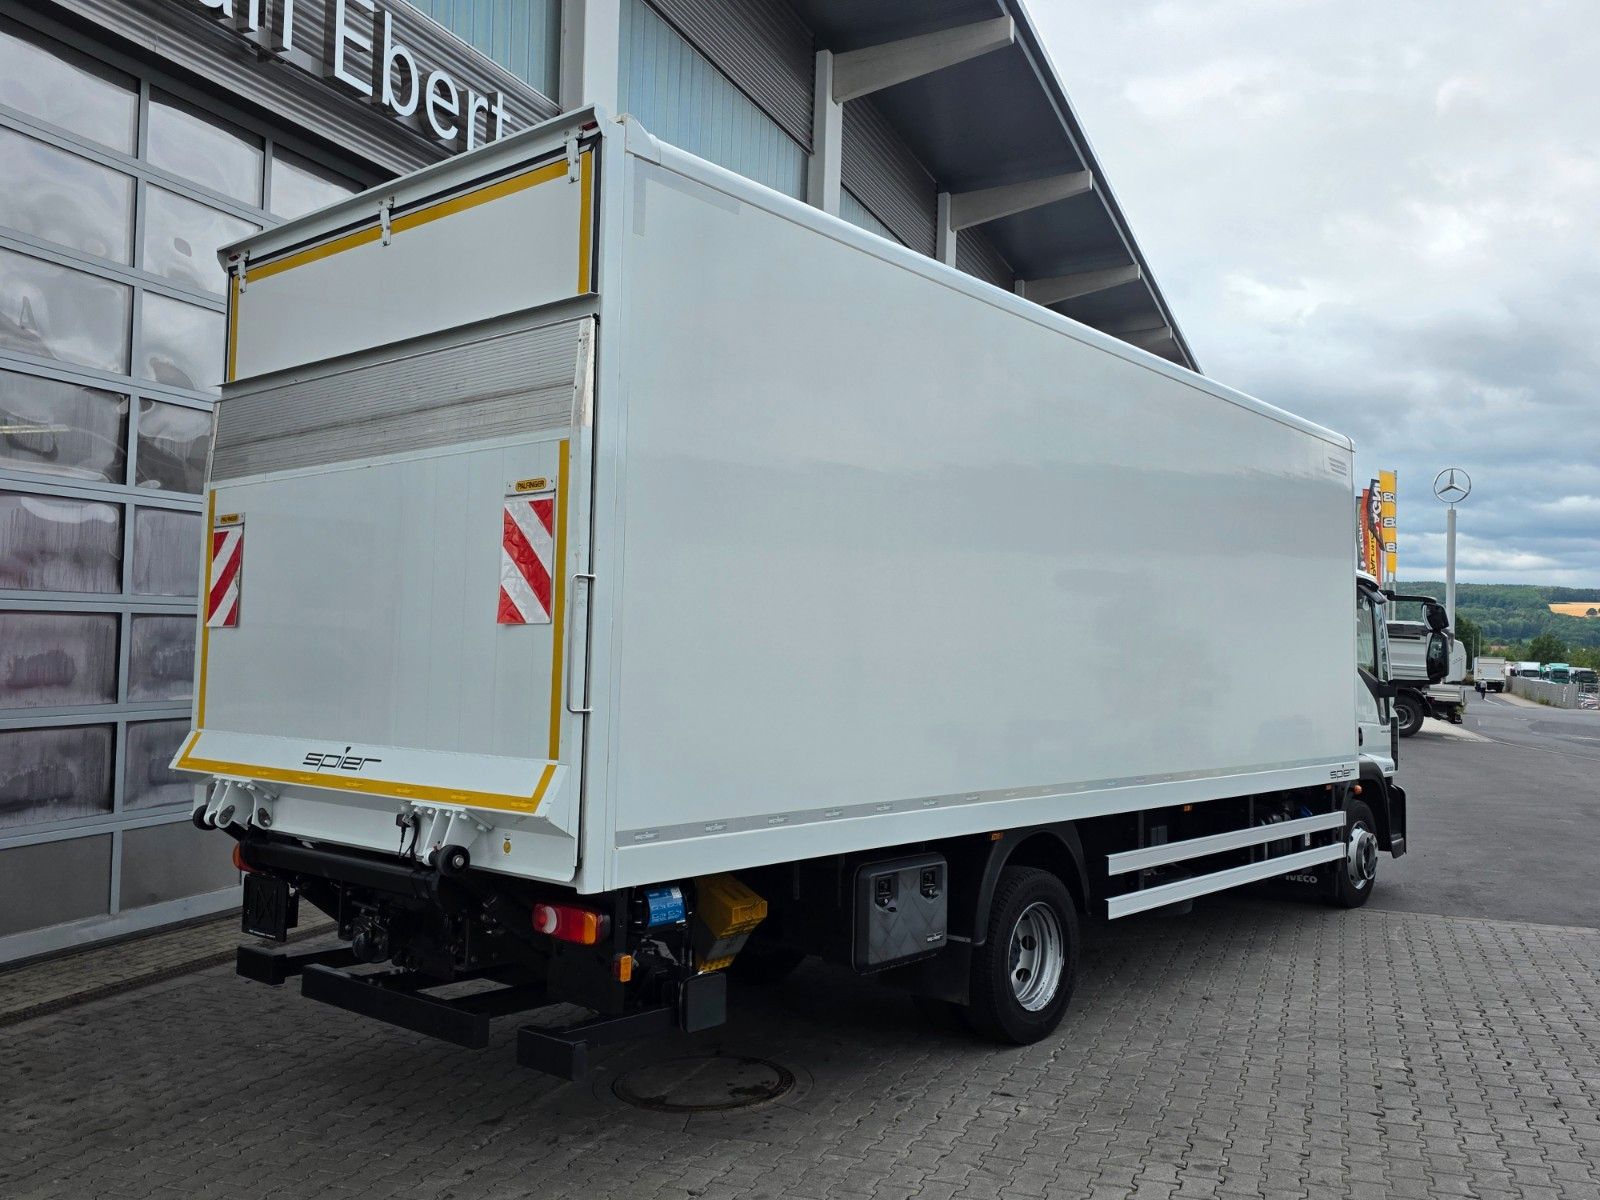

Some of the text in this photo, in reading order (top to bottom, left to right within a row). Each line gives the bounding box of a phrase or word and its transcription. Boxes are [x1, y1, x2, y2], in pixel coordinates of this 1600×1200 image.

[335, 0, 511, 150] Ebert
[303, 746, 382, 772] spier
[1330, 764, 1355, 780] spier
[1286, 875, 1317, 883] IVECO
